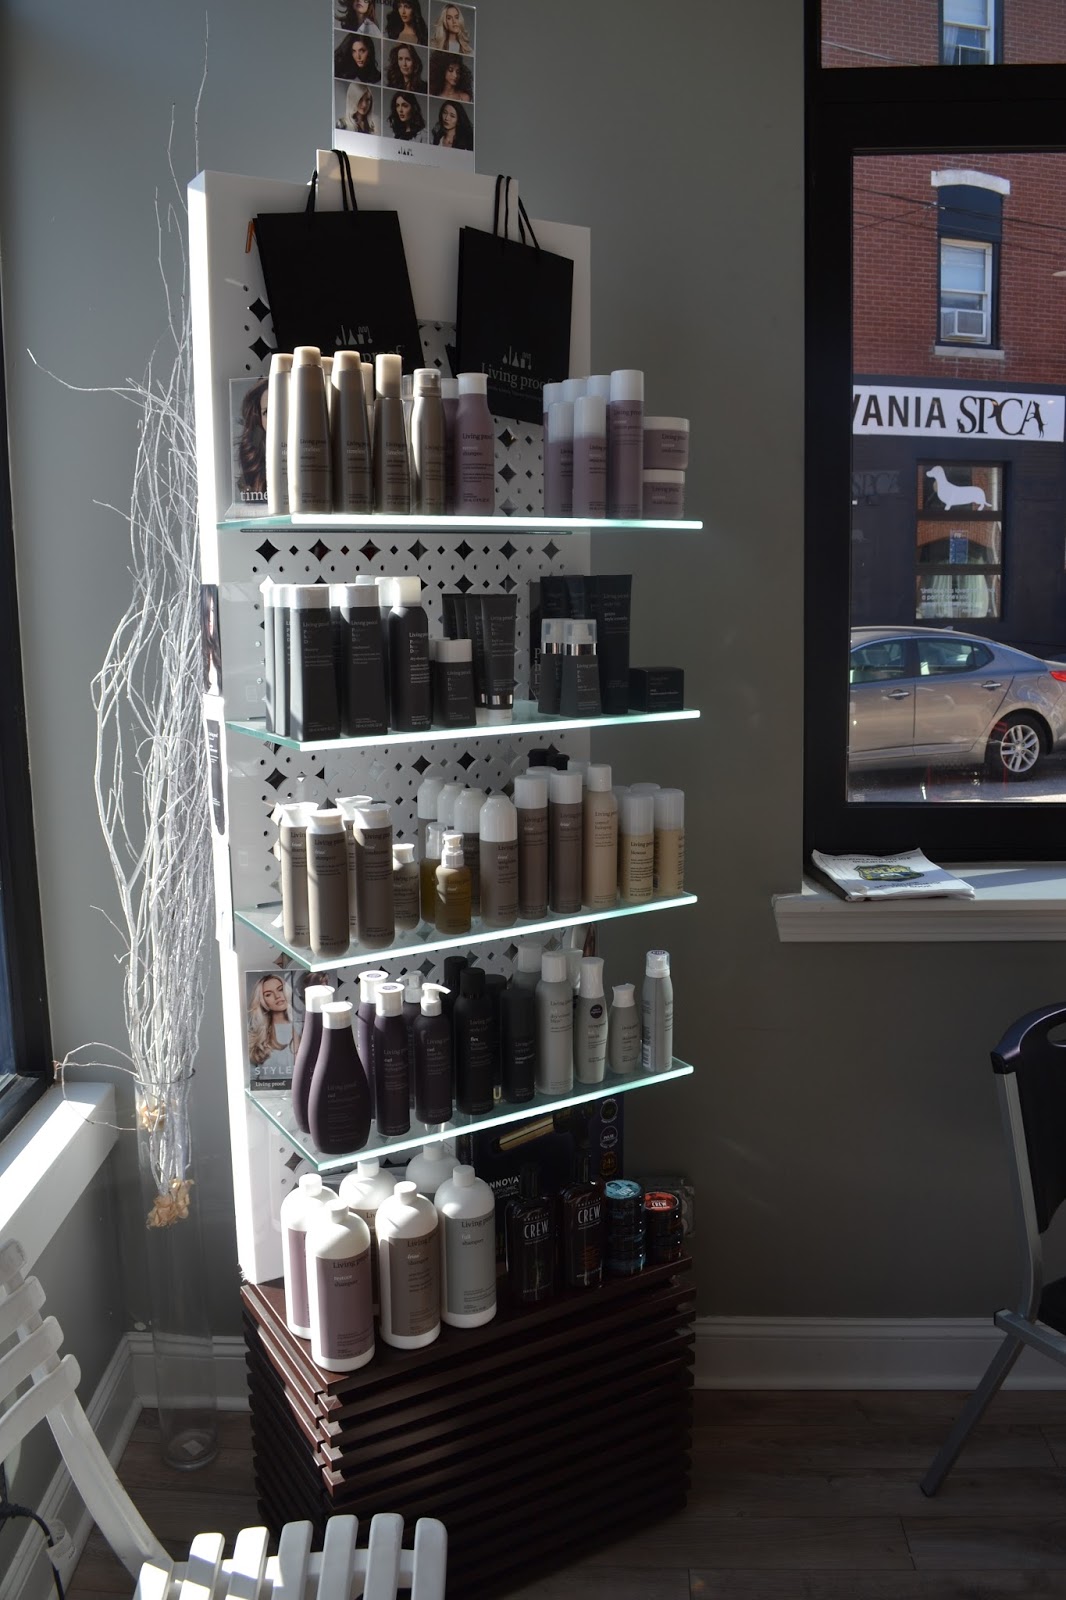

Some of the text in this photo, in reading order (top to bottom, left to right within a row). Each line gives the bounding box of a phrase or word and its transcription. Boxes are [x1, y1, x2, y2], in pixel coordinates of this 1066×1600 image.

[481, 362, 519, 389] Living
[957, 395, 1048, 439] SPCA
[315, 838, 332, 847] Living
[630, 840, 645, 849] Living
[255, 1080, 286, 1089] Living proof
[489, 1174, 521, 1190] NNOVA
[366, 1211, 376, 1222] Liv
[578, 1204, 602, 1224] CREW
[461, 1216, 482, 1229] Living
[524, 1220, 549, 1239] CREW
[407, 1236, 427, 1248] Living
[333, 1257, 357, 1271] Living
[333, 1272, 353, 1281] restore
